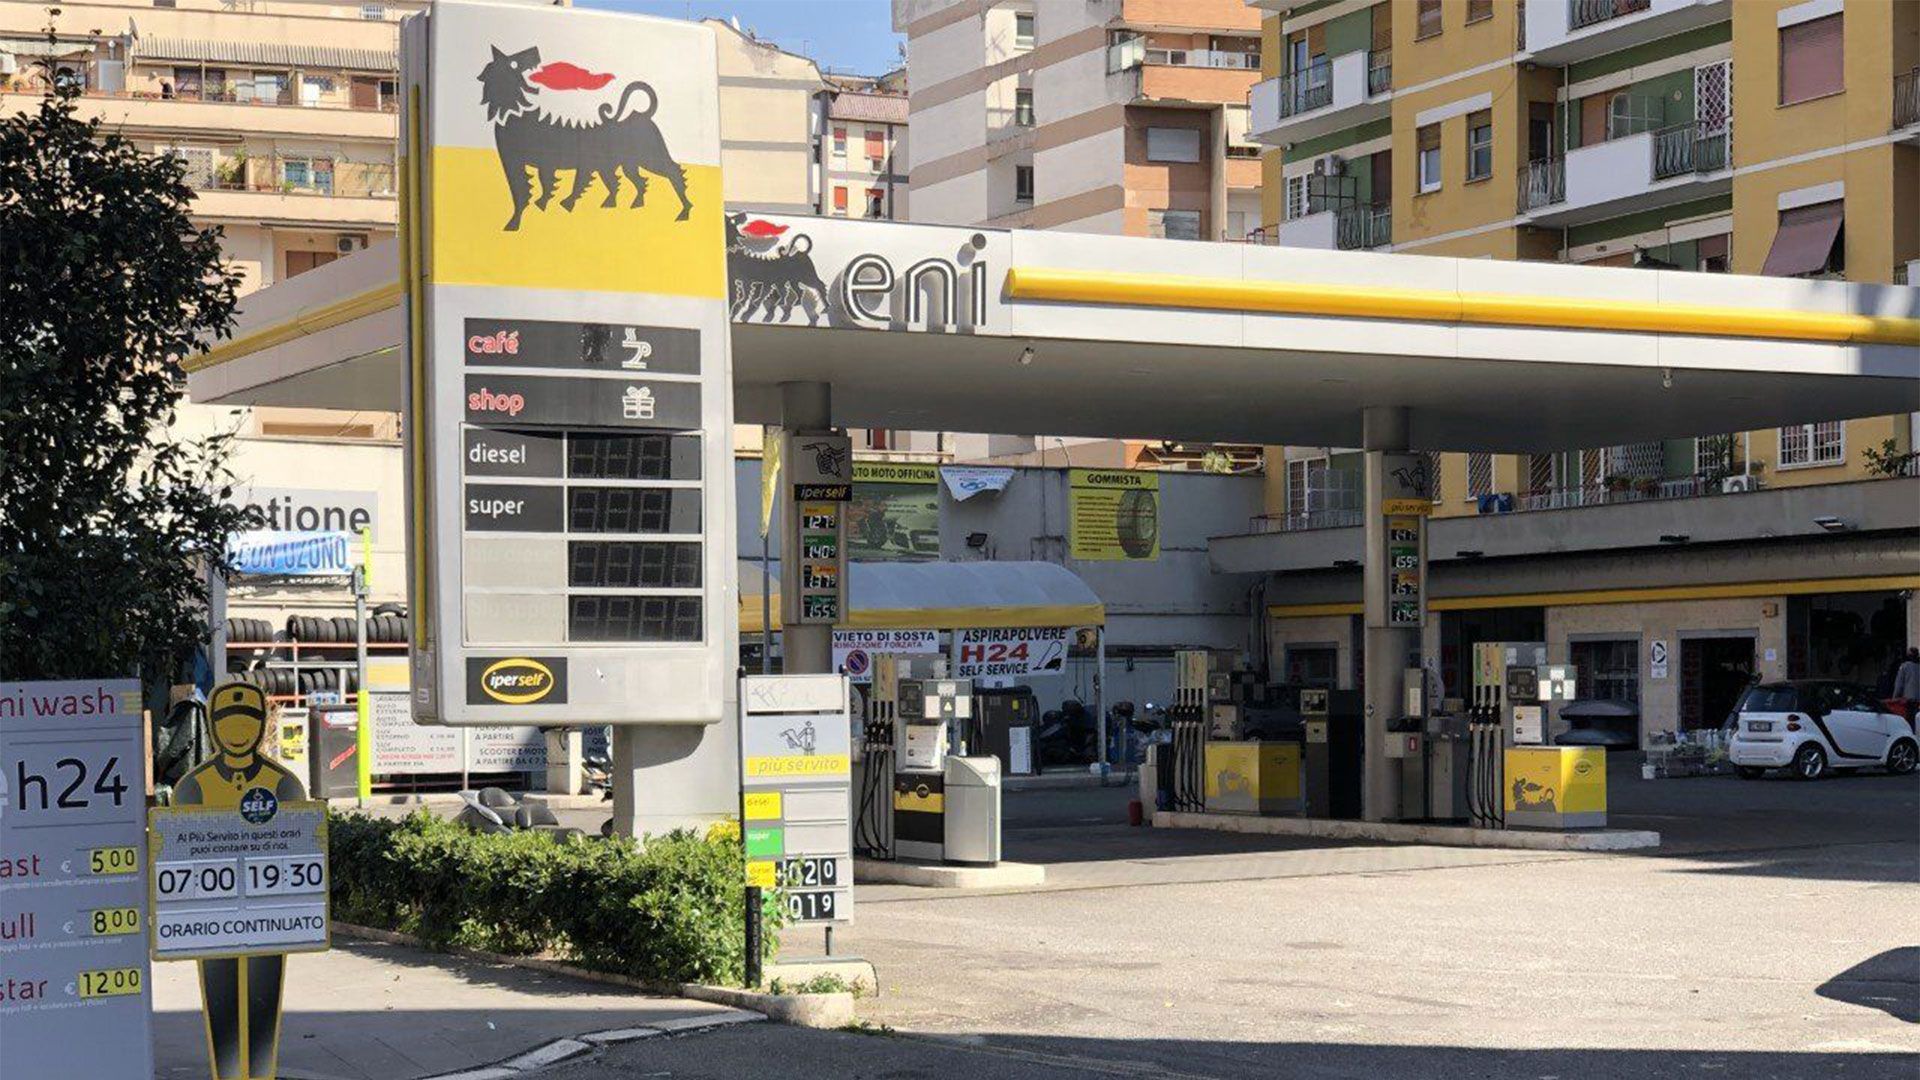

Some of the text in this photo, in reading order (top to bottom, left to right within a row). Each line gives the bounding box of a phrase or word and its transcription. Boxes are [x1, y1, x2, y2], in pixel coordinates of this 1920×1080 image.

[842, 233, 987, 325] eni
[468, 330, 520, 354] café
[468, 388, 525, 416] shop
[468, 443, 526, 464] diesel
[871, 467, 896, 479] MOTO
[898, 469, 935, 480] OFFICINA
[1087, 474, 1142, 485] GOMMISTA
[801, 486, 847, 498] iperself
[469, 498, 524, 518] super
[834, 632, 935, 641] VIETO DI SOSTA
[963, 628, 1066, 642] ASPIRAPOLVERE
[961, 643, 1029, 663] H24
[959, 663, 1028, 677] SELF SERVICE
[490, 672, 544, 689] iperself
[32, 687, 115, 716] wash
[17, 756, 129, 811] h24
[242, 801, 275, 812] SELF
[158, 867, 236, 894] 07:00
[248, 863, 324, 889] 19:30
[160, 915, 324, 938] ORARIO CONTINUATO
